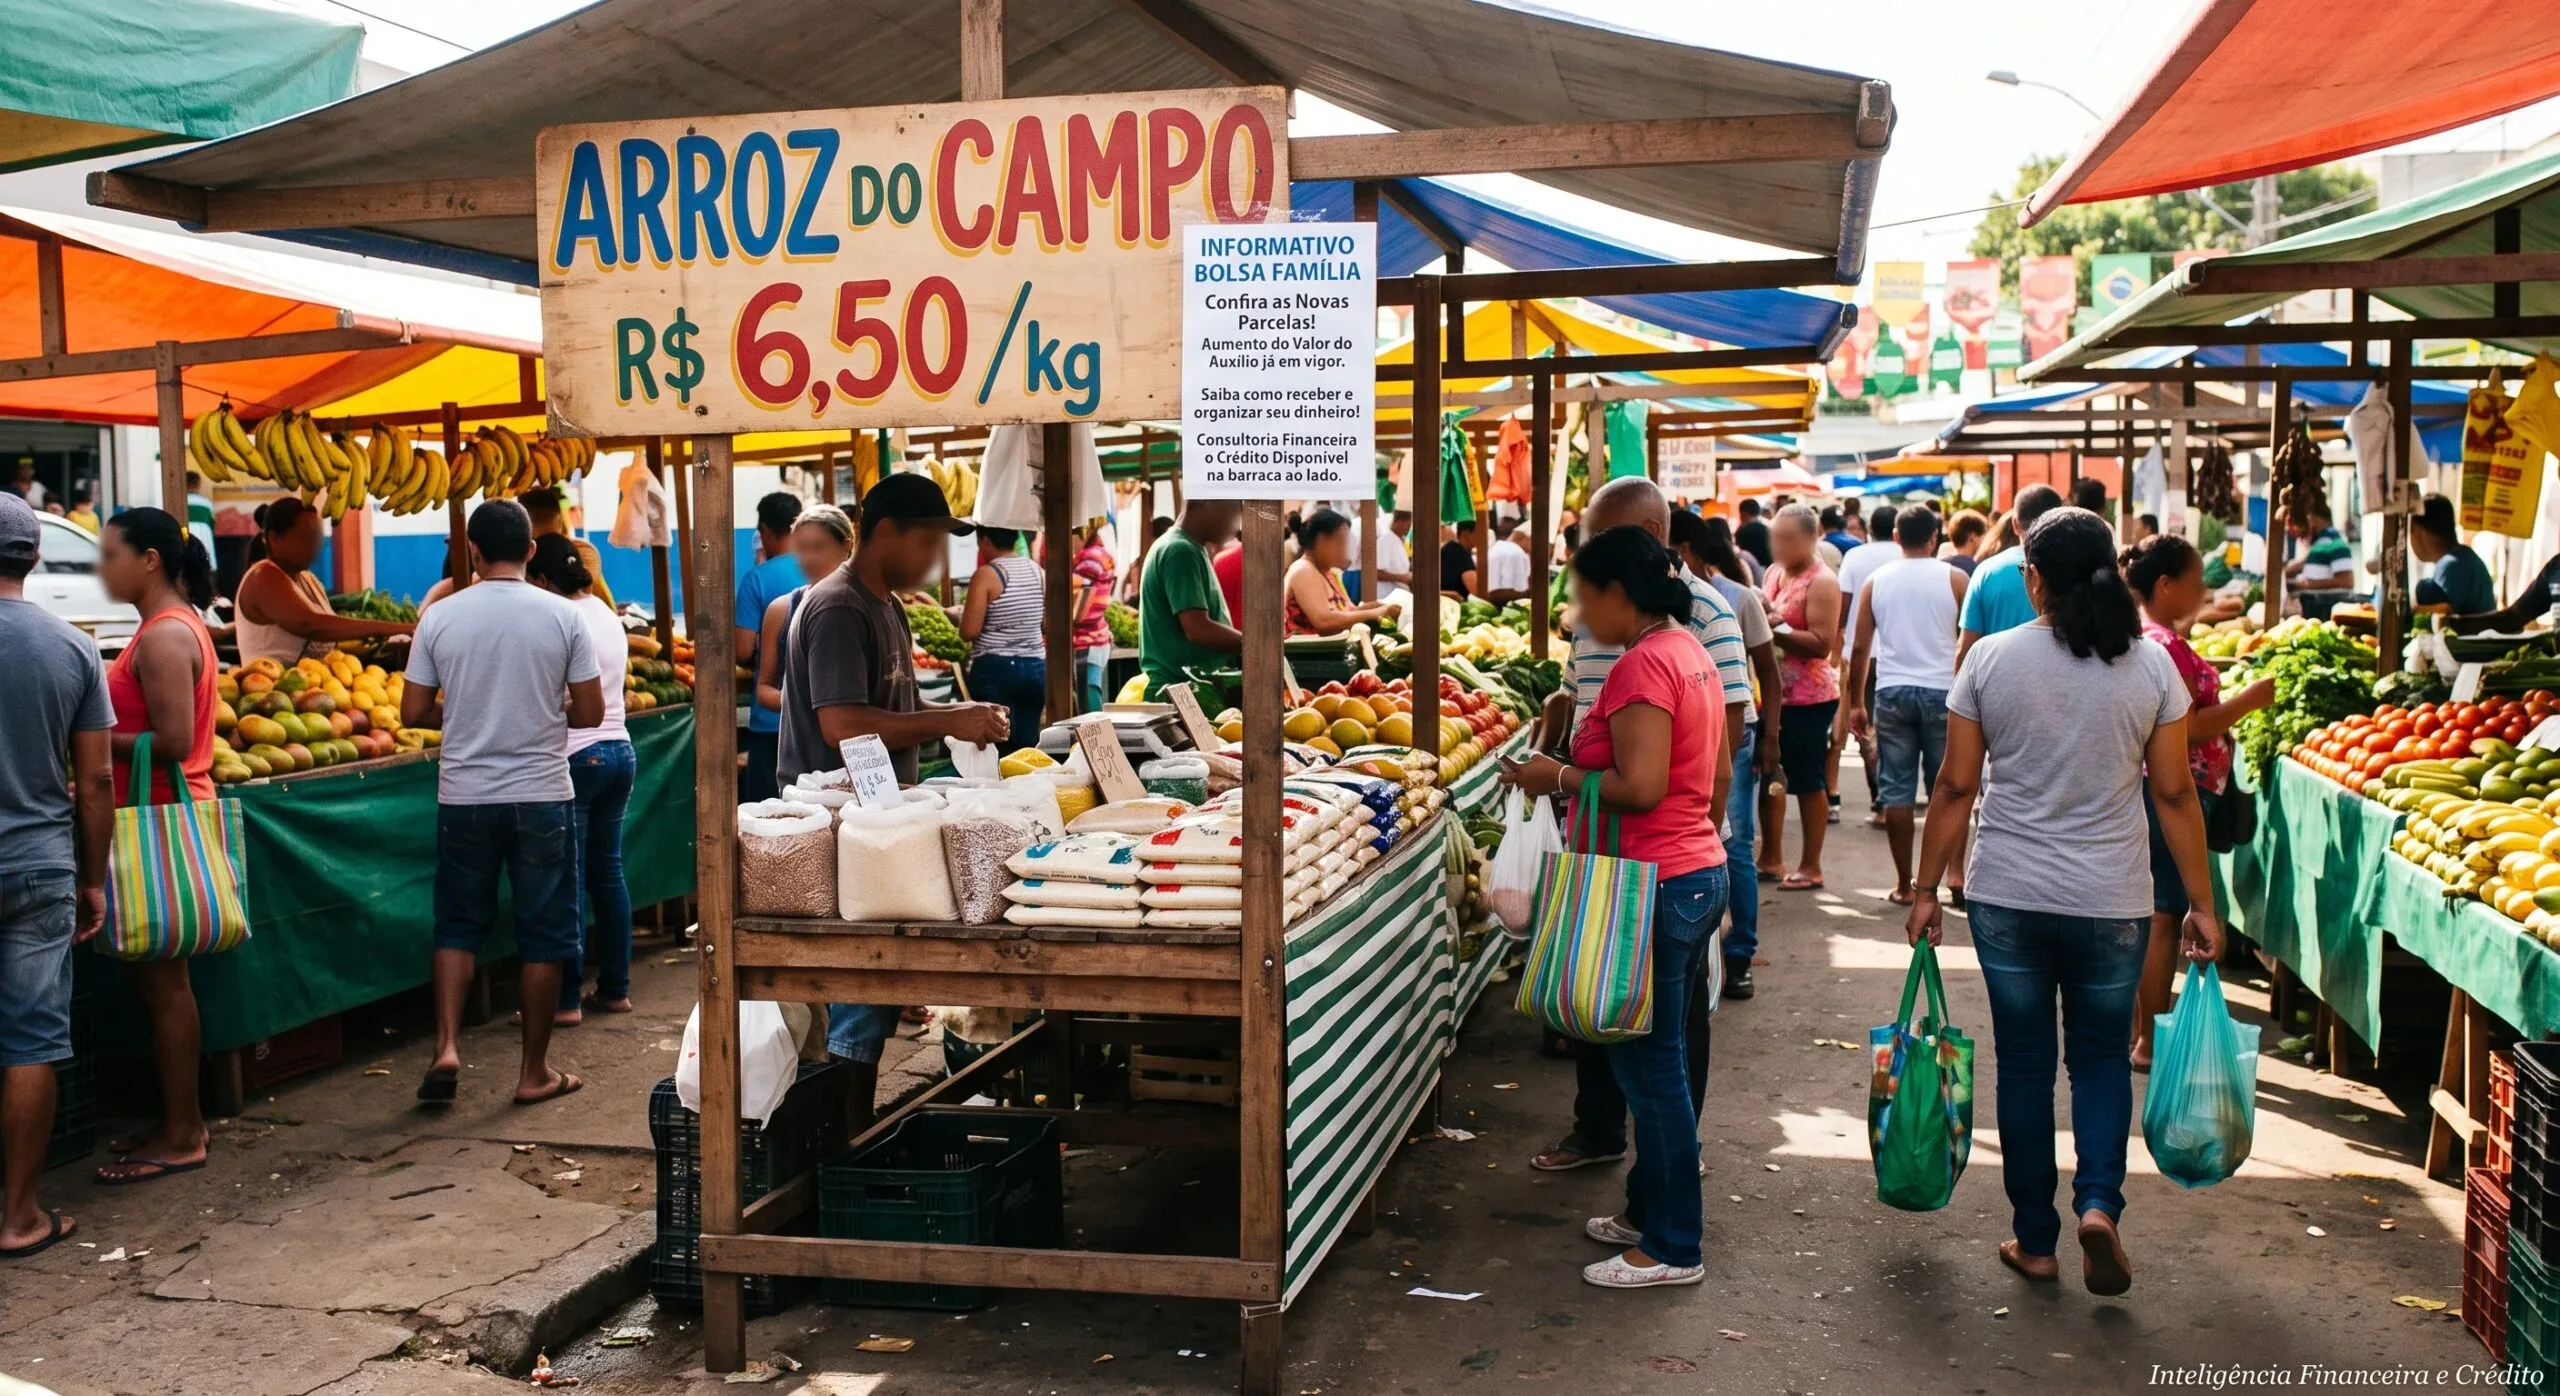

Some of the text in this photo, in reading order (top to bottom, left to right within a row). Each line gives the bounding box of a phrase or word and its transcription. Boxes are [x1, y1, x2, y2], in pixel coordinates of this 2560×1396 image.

[552, 103, 1275, 270] ARROZ DO CAMPO
[1201, 236, 1355, 257] INFORMATIVO
[1194, 258, 1361, 283] BOLSA FAMÍLIA
[1205, 293, 1349, 310] Confira as Novas
[1238, 313, 1316, 330] Parcelas!
[614, 276, 1101, 416] R$ 6,50 /kg
[1201, 336, 1353, 351] Aumento do Valor do
[1261, 354, 1275, 372] já
[1278, 357, 1301, 368] em
[1304, 354, 1345, 371] vigor.
[1201, 386, 1354, 401] Saiba como receber e
[1193, 404, 1360, 423] organizar seu dinheiro!
[1196, 432, 1357, 447] Consultoria Financeira
[1204, 454, 1214, 464] o
[1216, 450, 1269, 464] Crédito
[1207, 467, 1342, 482] na barraca ao lado.
